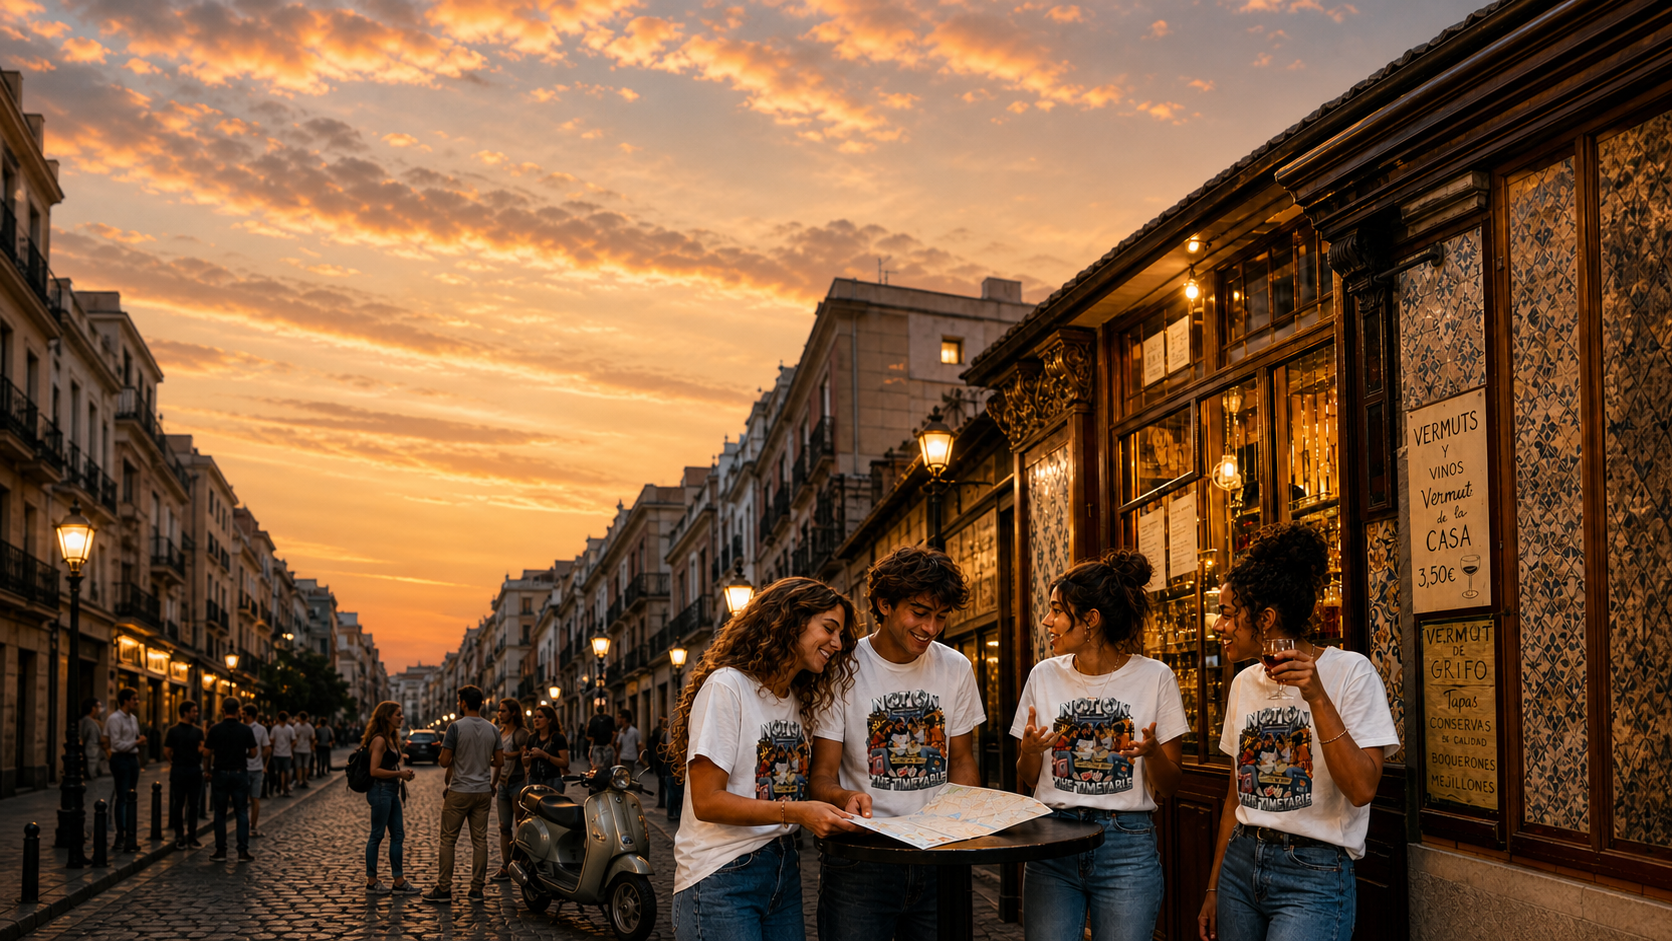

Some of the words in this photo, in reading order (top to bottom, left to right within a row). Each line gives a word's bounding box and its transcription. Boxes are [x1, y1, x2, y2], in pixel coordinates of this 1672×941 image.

[1413, 410, 1478, 446] VERMUTS
[1441, 444, 1449, 458] Y
[1429, 460, 1464, 480] VINOS
[1420, 481, 1472, 509] Vermut
[1436, 510, 1447, 524] de
[1454, 505, 1467, 519] la
[1426, 524, 1471, 551] CASA
[1418, 565, 1456, 588] 3,50€
[1452, 645, 1465, 656] DE
[1431, 660, 1487, 680] GRIFO
[1443, 689, 1478, 713] Tapas
[1429, 717, 1491, 732] CONSERVAS
[1453, 735, 1487, 747] CALIDAD
[1431, 752, 1495, 771] BOQUERONES
[1431, 774, 1495, 794] MEJILLONES
